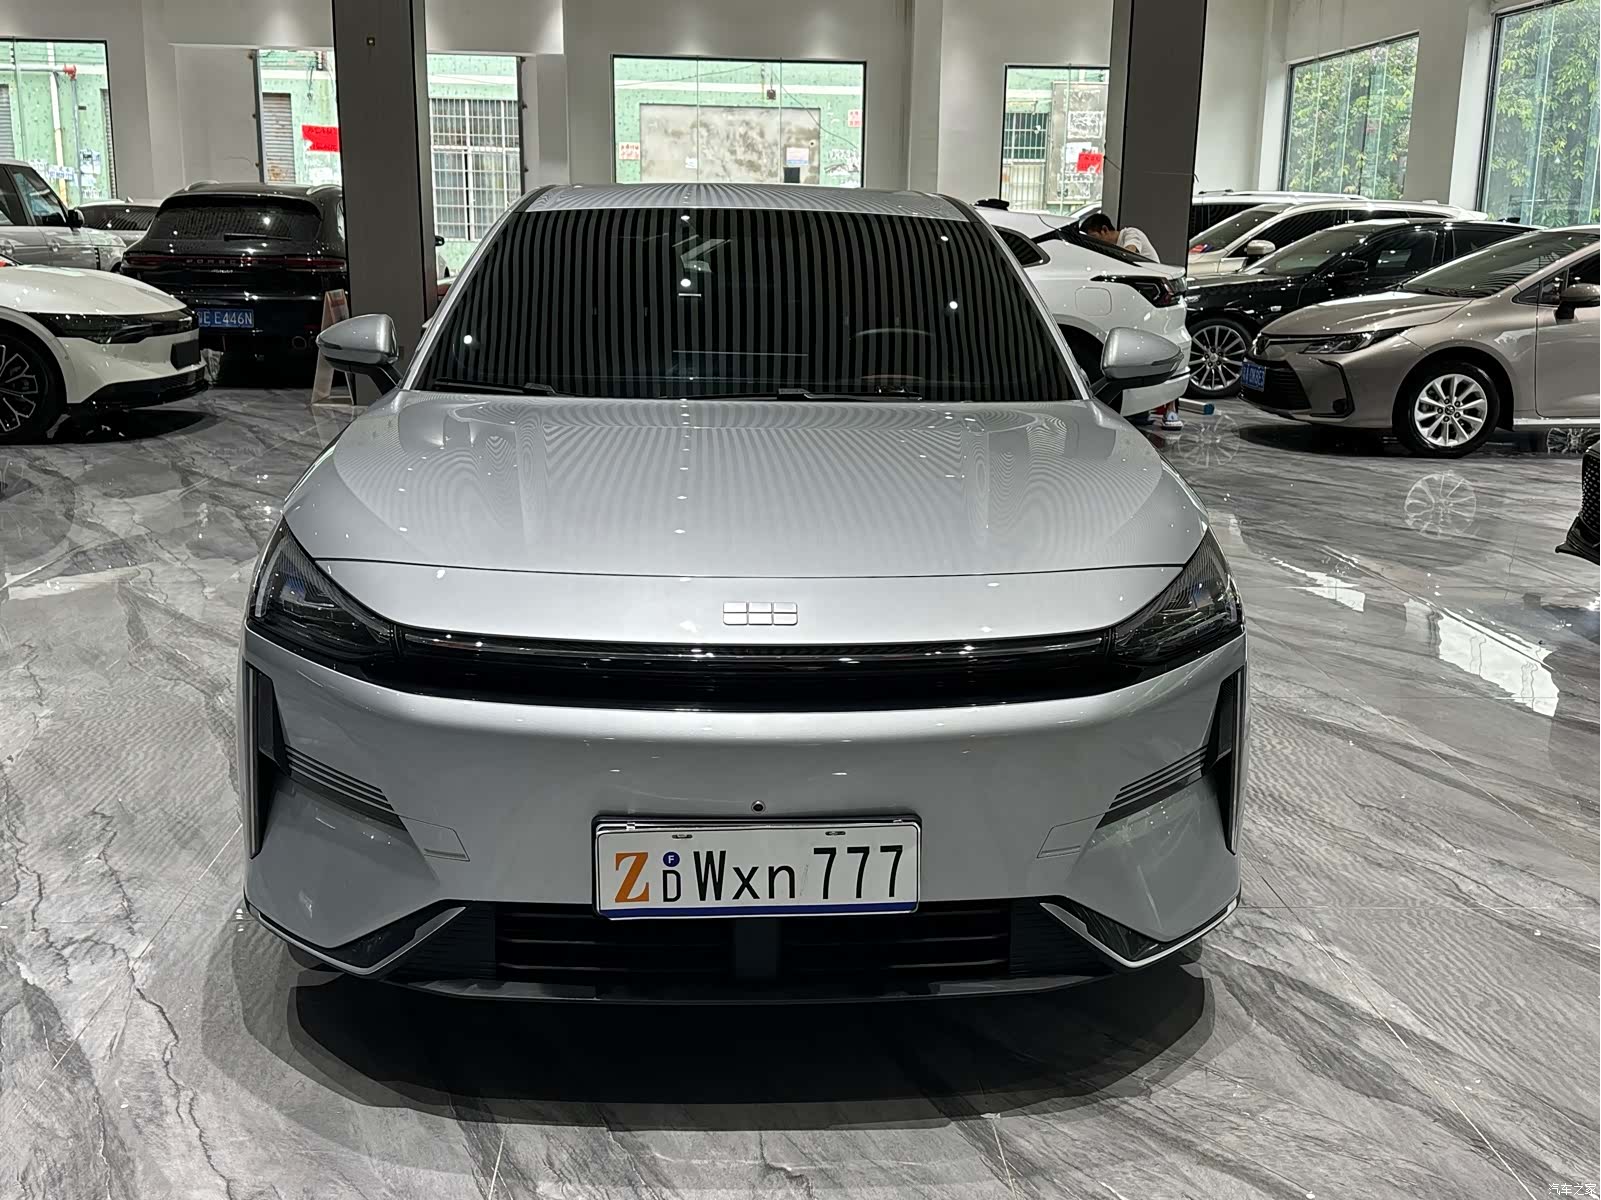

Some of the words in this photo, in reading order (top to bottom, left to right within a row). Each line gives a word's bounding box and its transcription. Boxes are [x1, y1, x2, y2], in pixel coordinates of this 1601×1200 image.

[614, 851, 650, 903] Z
[662, 869, 682, 903] D
[693, 850, 796, 901] Wxn
[813, 844, 903, 900] 777
